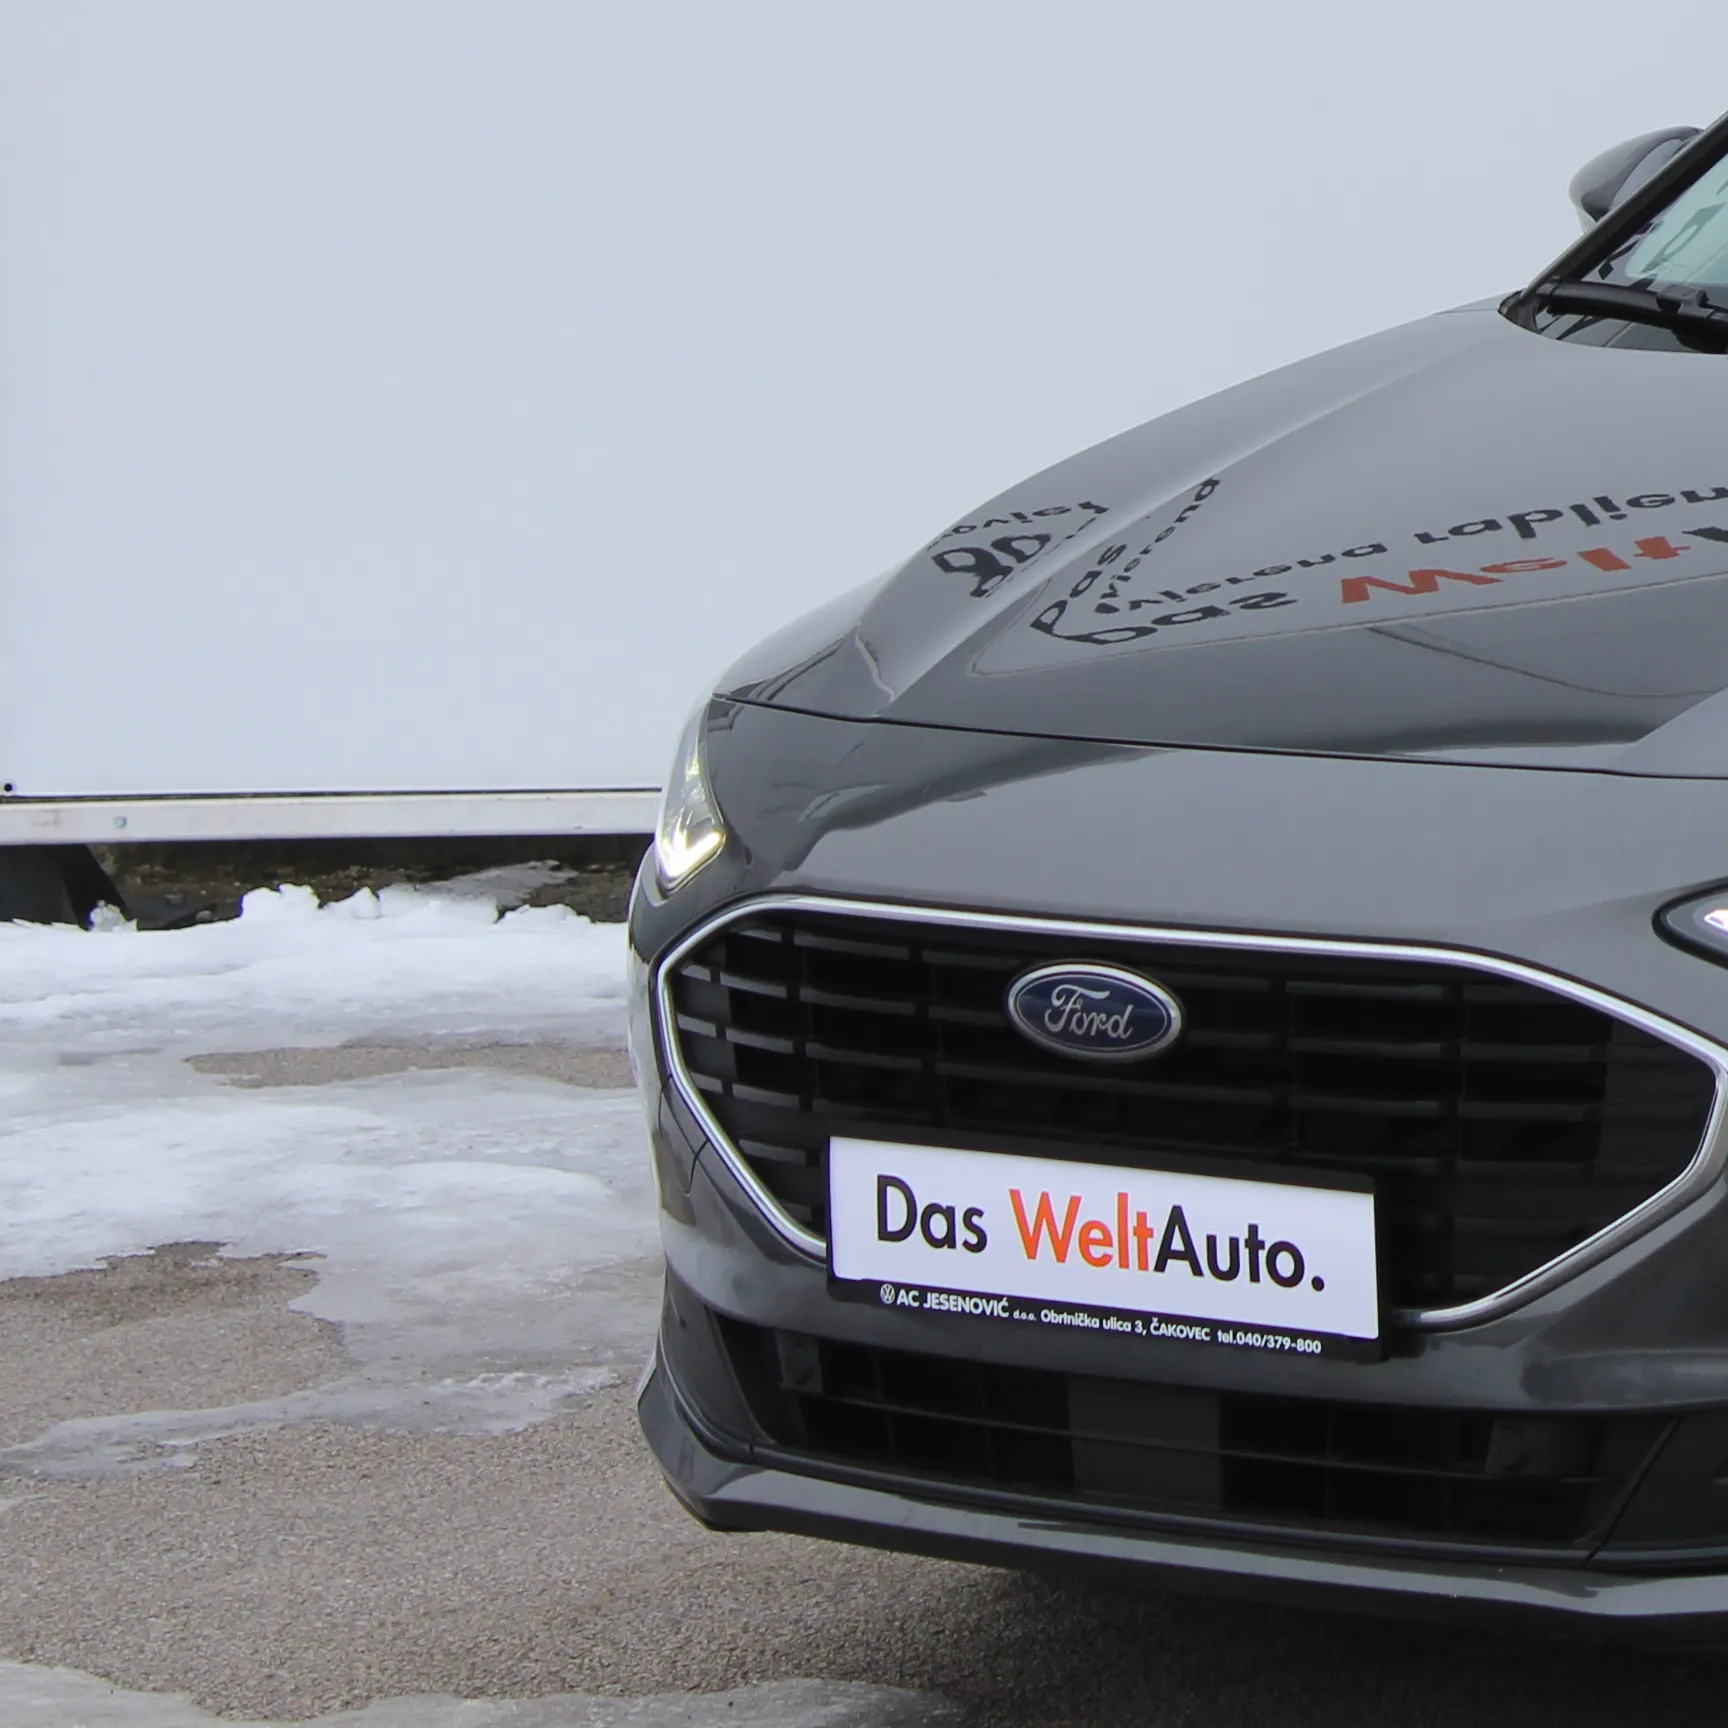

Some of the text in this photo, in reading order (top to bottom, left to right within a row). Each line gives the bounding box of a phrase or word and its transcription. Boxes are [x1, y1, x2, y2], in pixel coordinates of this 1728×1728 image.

[1043, 983, 1134, 1040] Ford
[876, 1173, 1325, 1293] Das WeltAuto.
[896, 1288, 920, 1308] AC
[923, 1291, 1010, 1318] JESENOVIĆ
[1040, 1309, 1100, 1329] Obrtnička
[1102, 1316, 1132, 1333] ulica
[1135, 1319, 1147, 1336] 3,
[1150, 1317, 1211, 1341] ČAKOVEC
